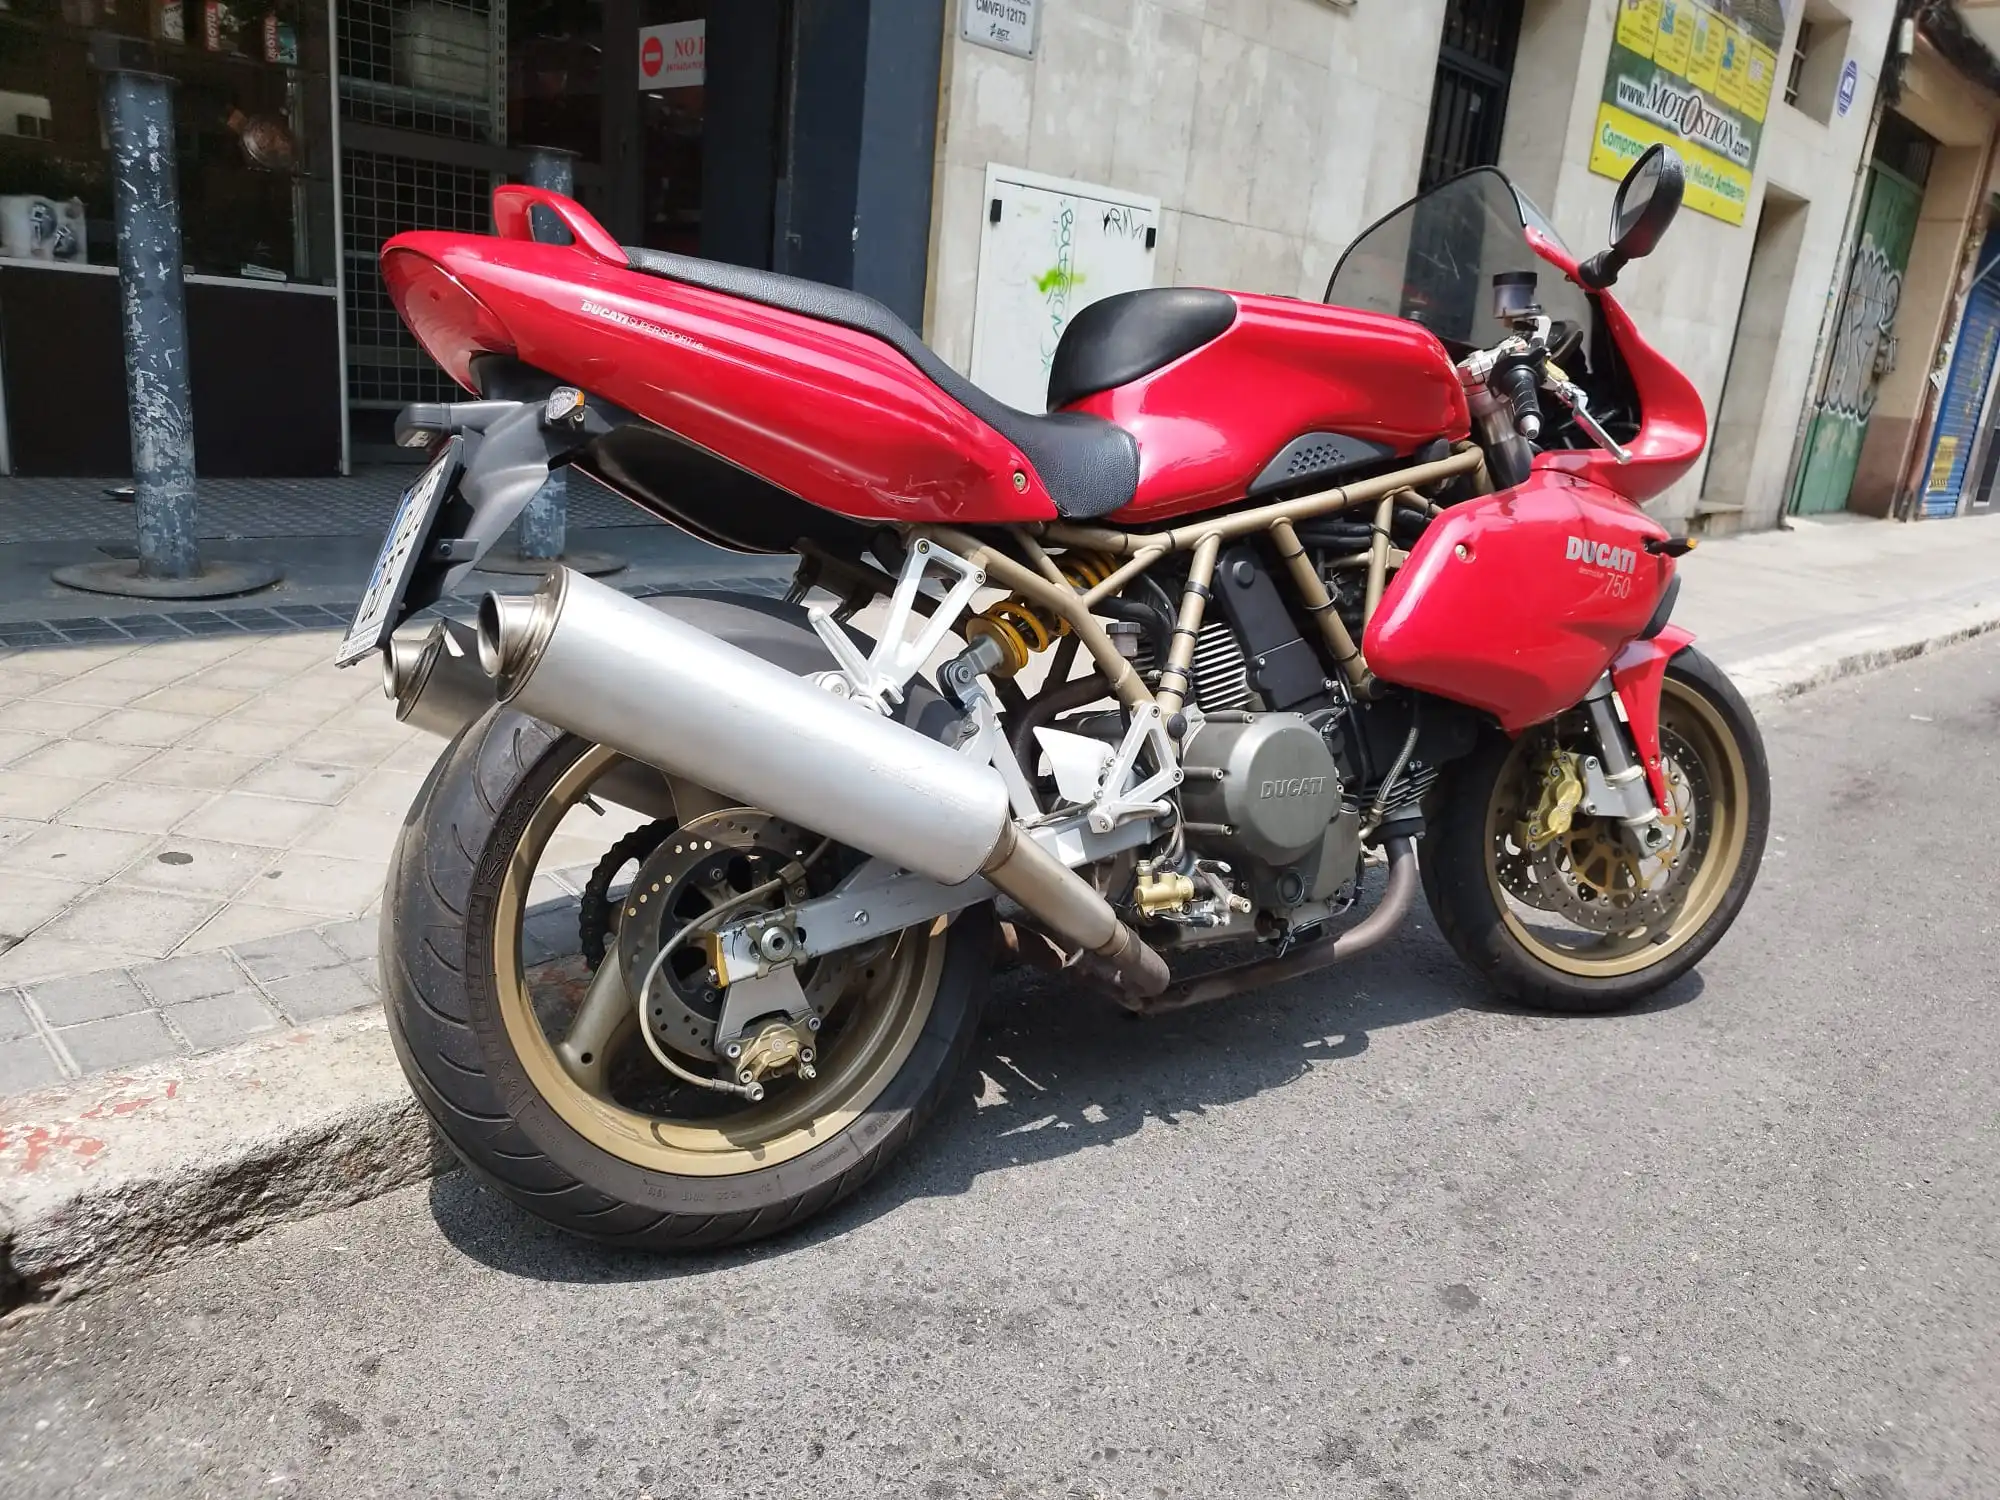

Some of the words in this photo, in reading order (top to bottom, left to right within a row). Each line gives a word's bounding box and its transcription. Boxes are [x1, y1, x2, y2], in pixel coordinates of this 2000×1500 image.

[1006, 7, 1027, 25] 12173
[580, 299, 629, 325] DUCATI
[1566, 535, 1636, 574] DUCATI
[1604, 572, 1631, 599] 750
[1260, 776, 1327, 800] DUCATI
